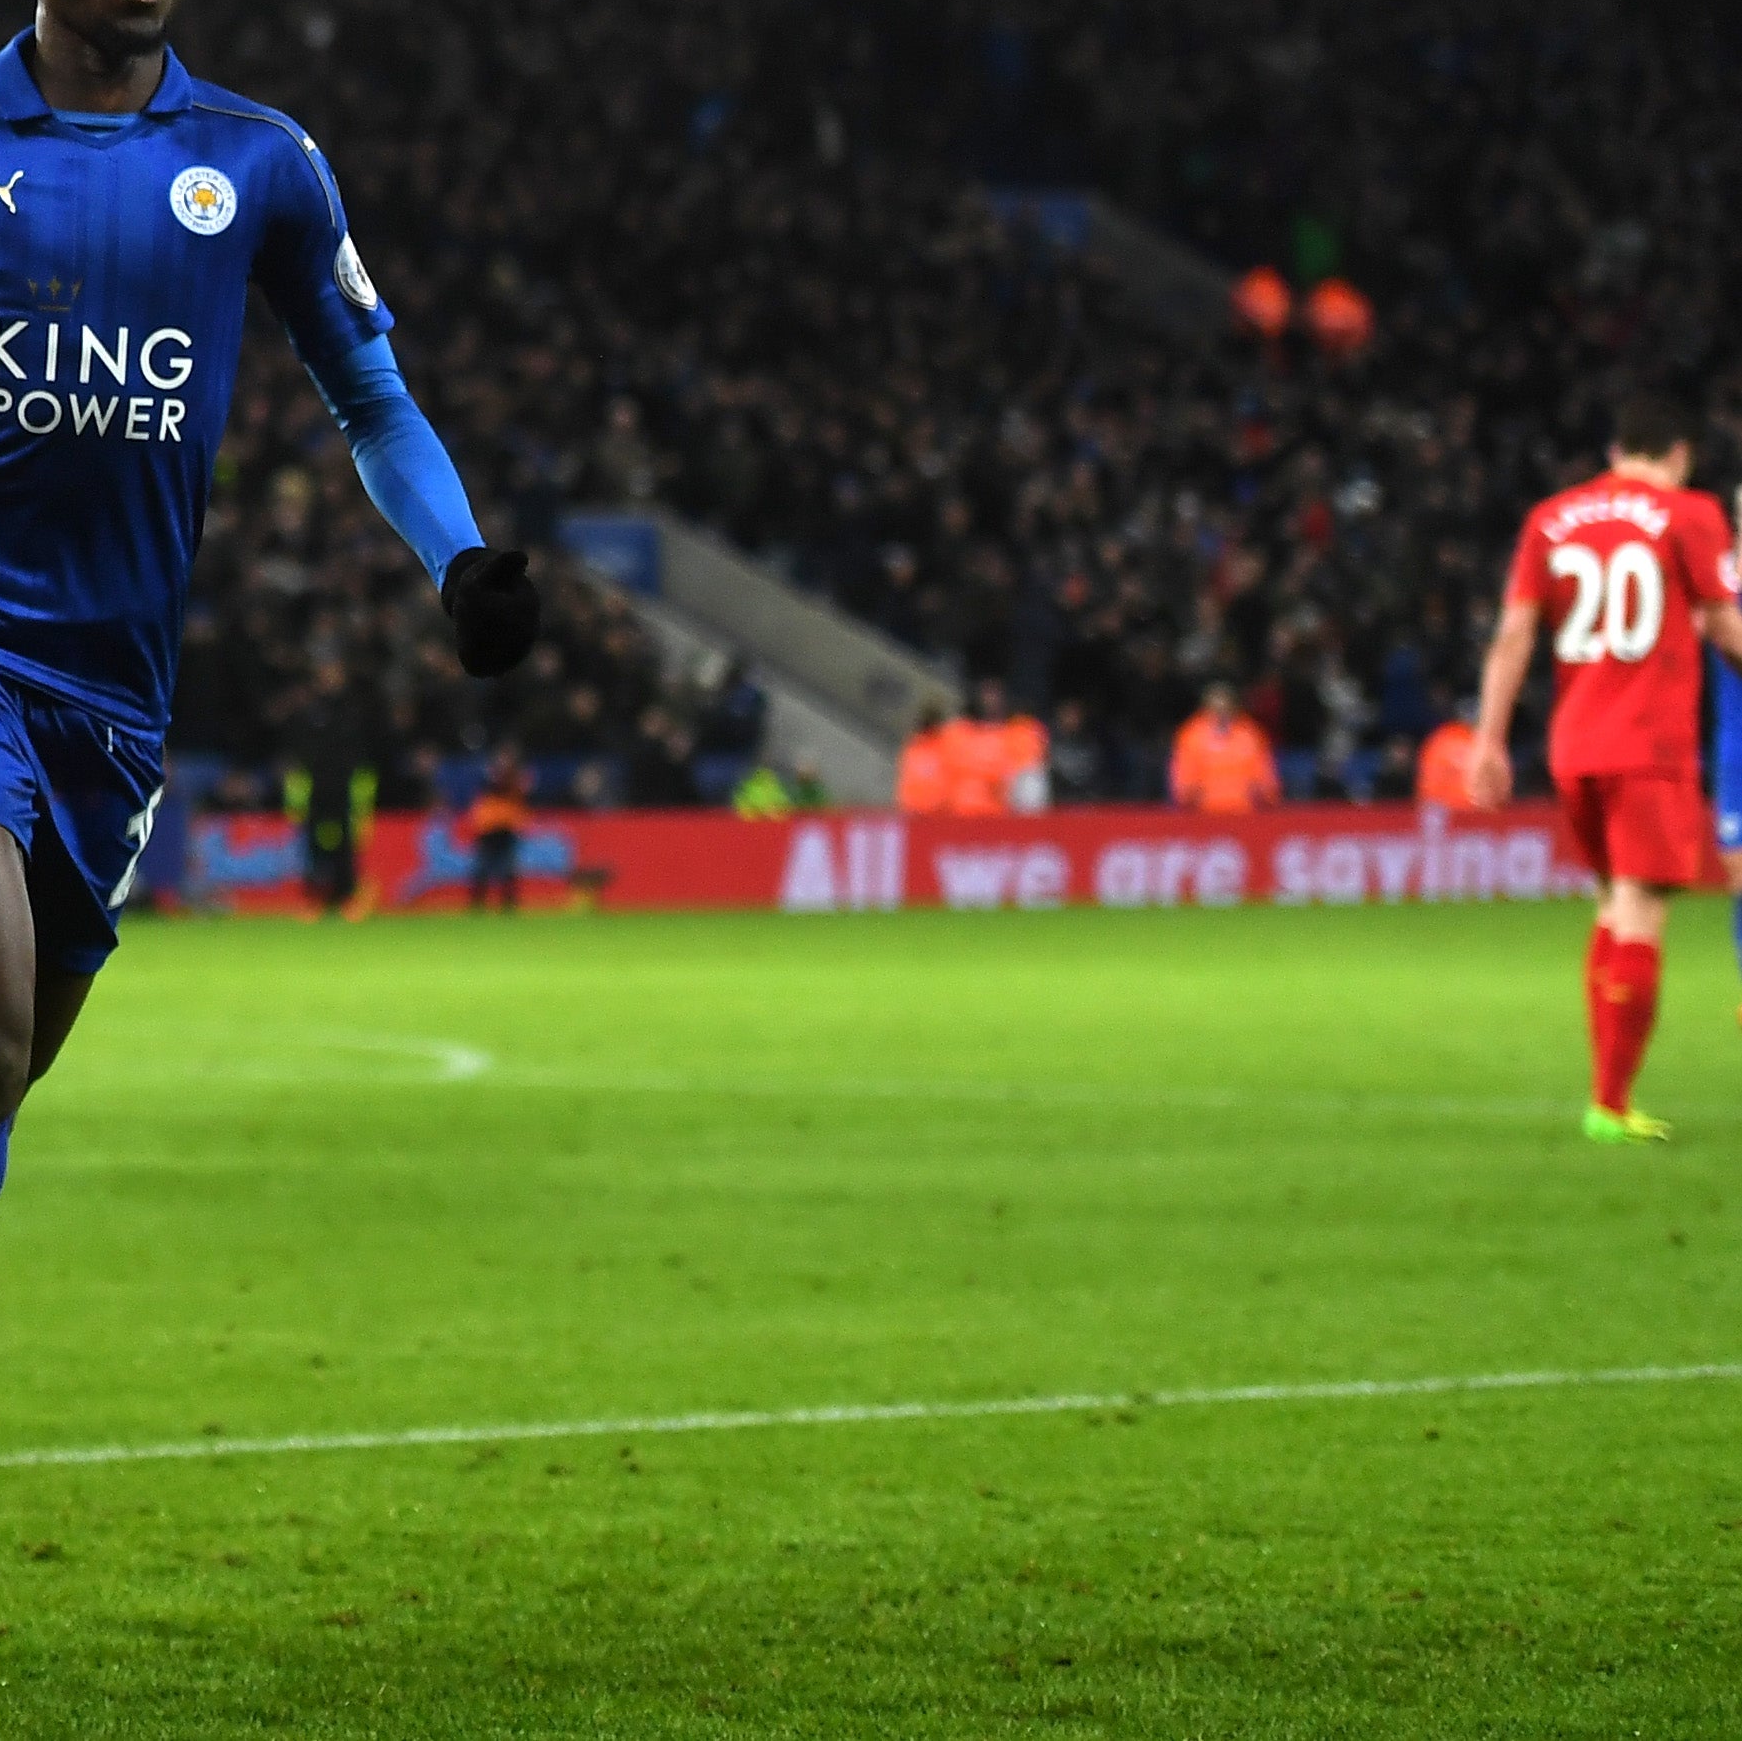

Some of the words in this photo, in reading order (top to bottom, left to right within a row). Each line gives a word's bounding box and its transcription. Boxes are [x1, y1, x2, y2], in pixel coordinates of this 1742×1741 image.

[1548, 541, 1664, 664] 20
[779, 822, 904, 912] All
[933, 841, 1071, 911] we
[1095, 838, 1247, 908] are
